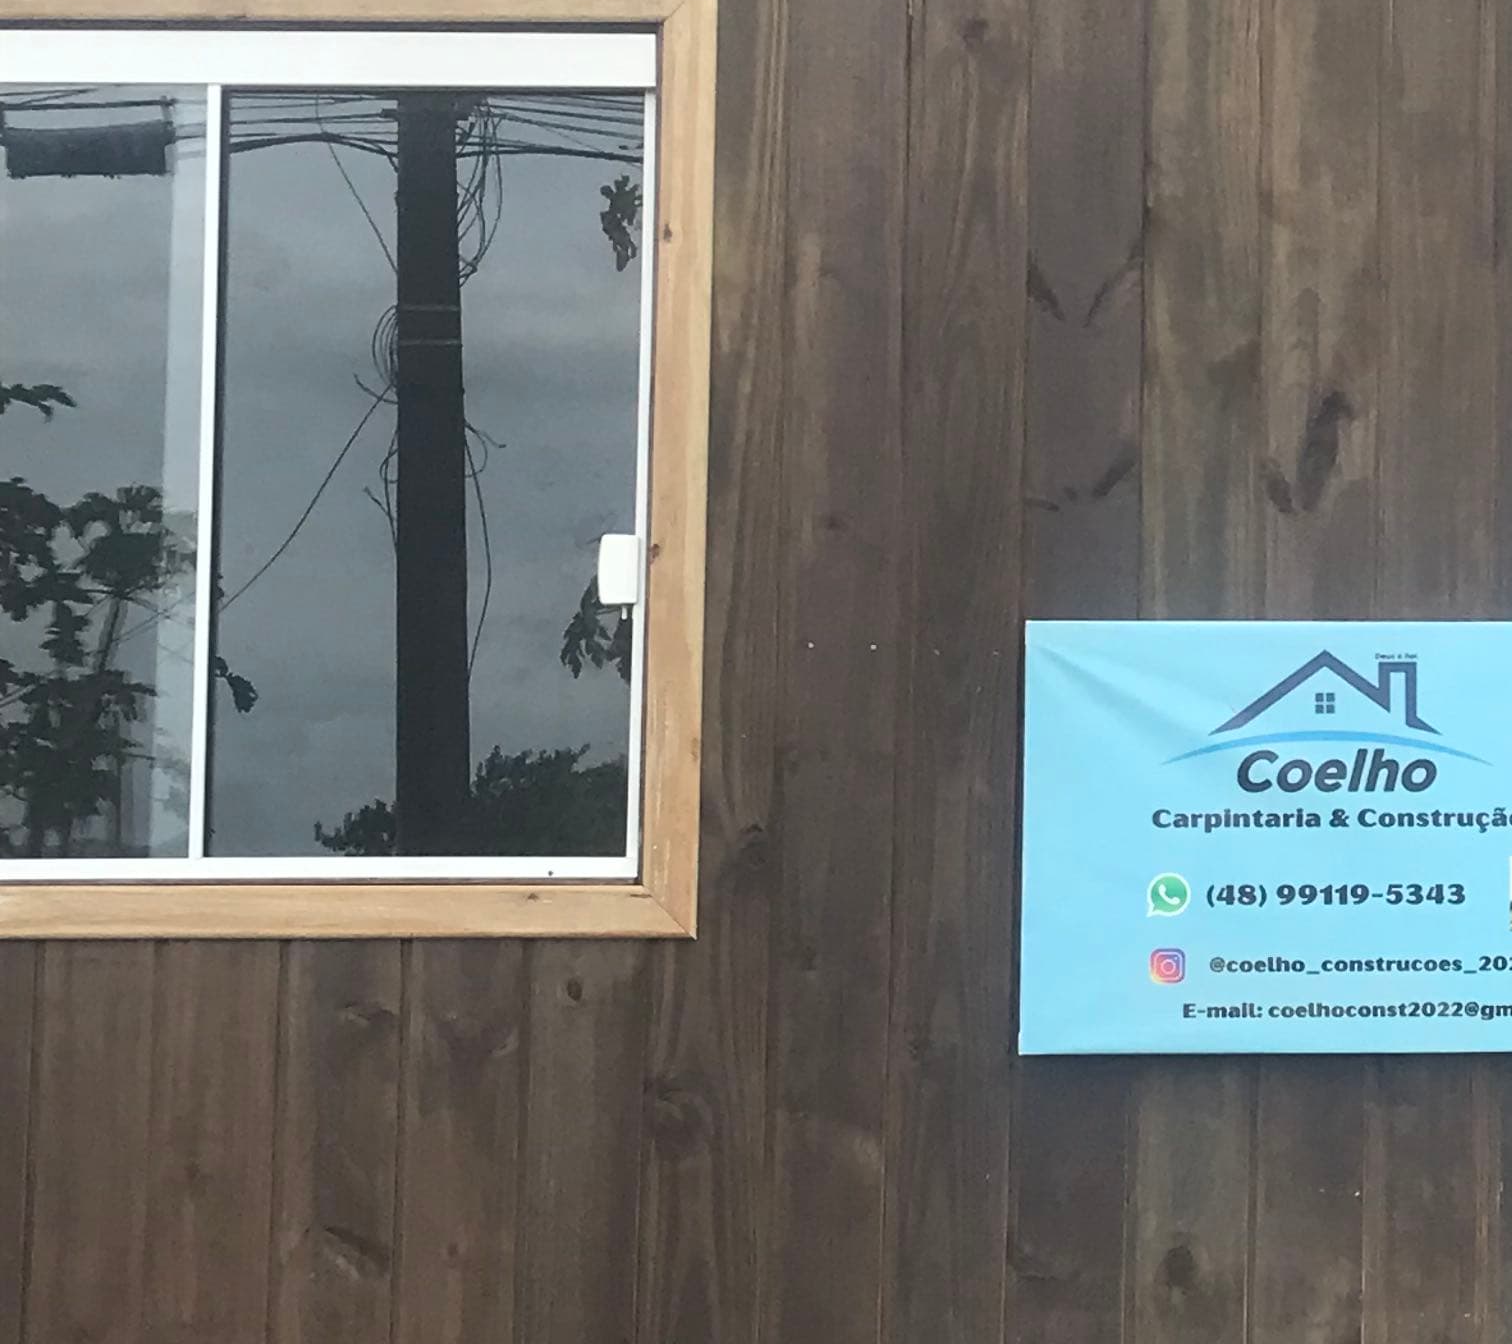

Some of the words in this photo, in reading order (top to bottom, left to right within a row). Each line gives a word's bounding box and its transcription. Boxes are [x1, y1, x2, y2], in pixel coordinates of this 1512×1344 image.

[1236, 748, 1438, 794] Coelho
[1151, 807, 1322, 834] Carpintaria
[1328, 808, 1350, 828] &
[1205, 883, 1268, 909] (48)
[1275, 883, 1466, 906] 99119-5343
[1182, 1001, 1263, 1019] E-mail:
